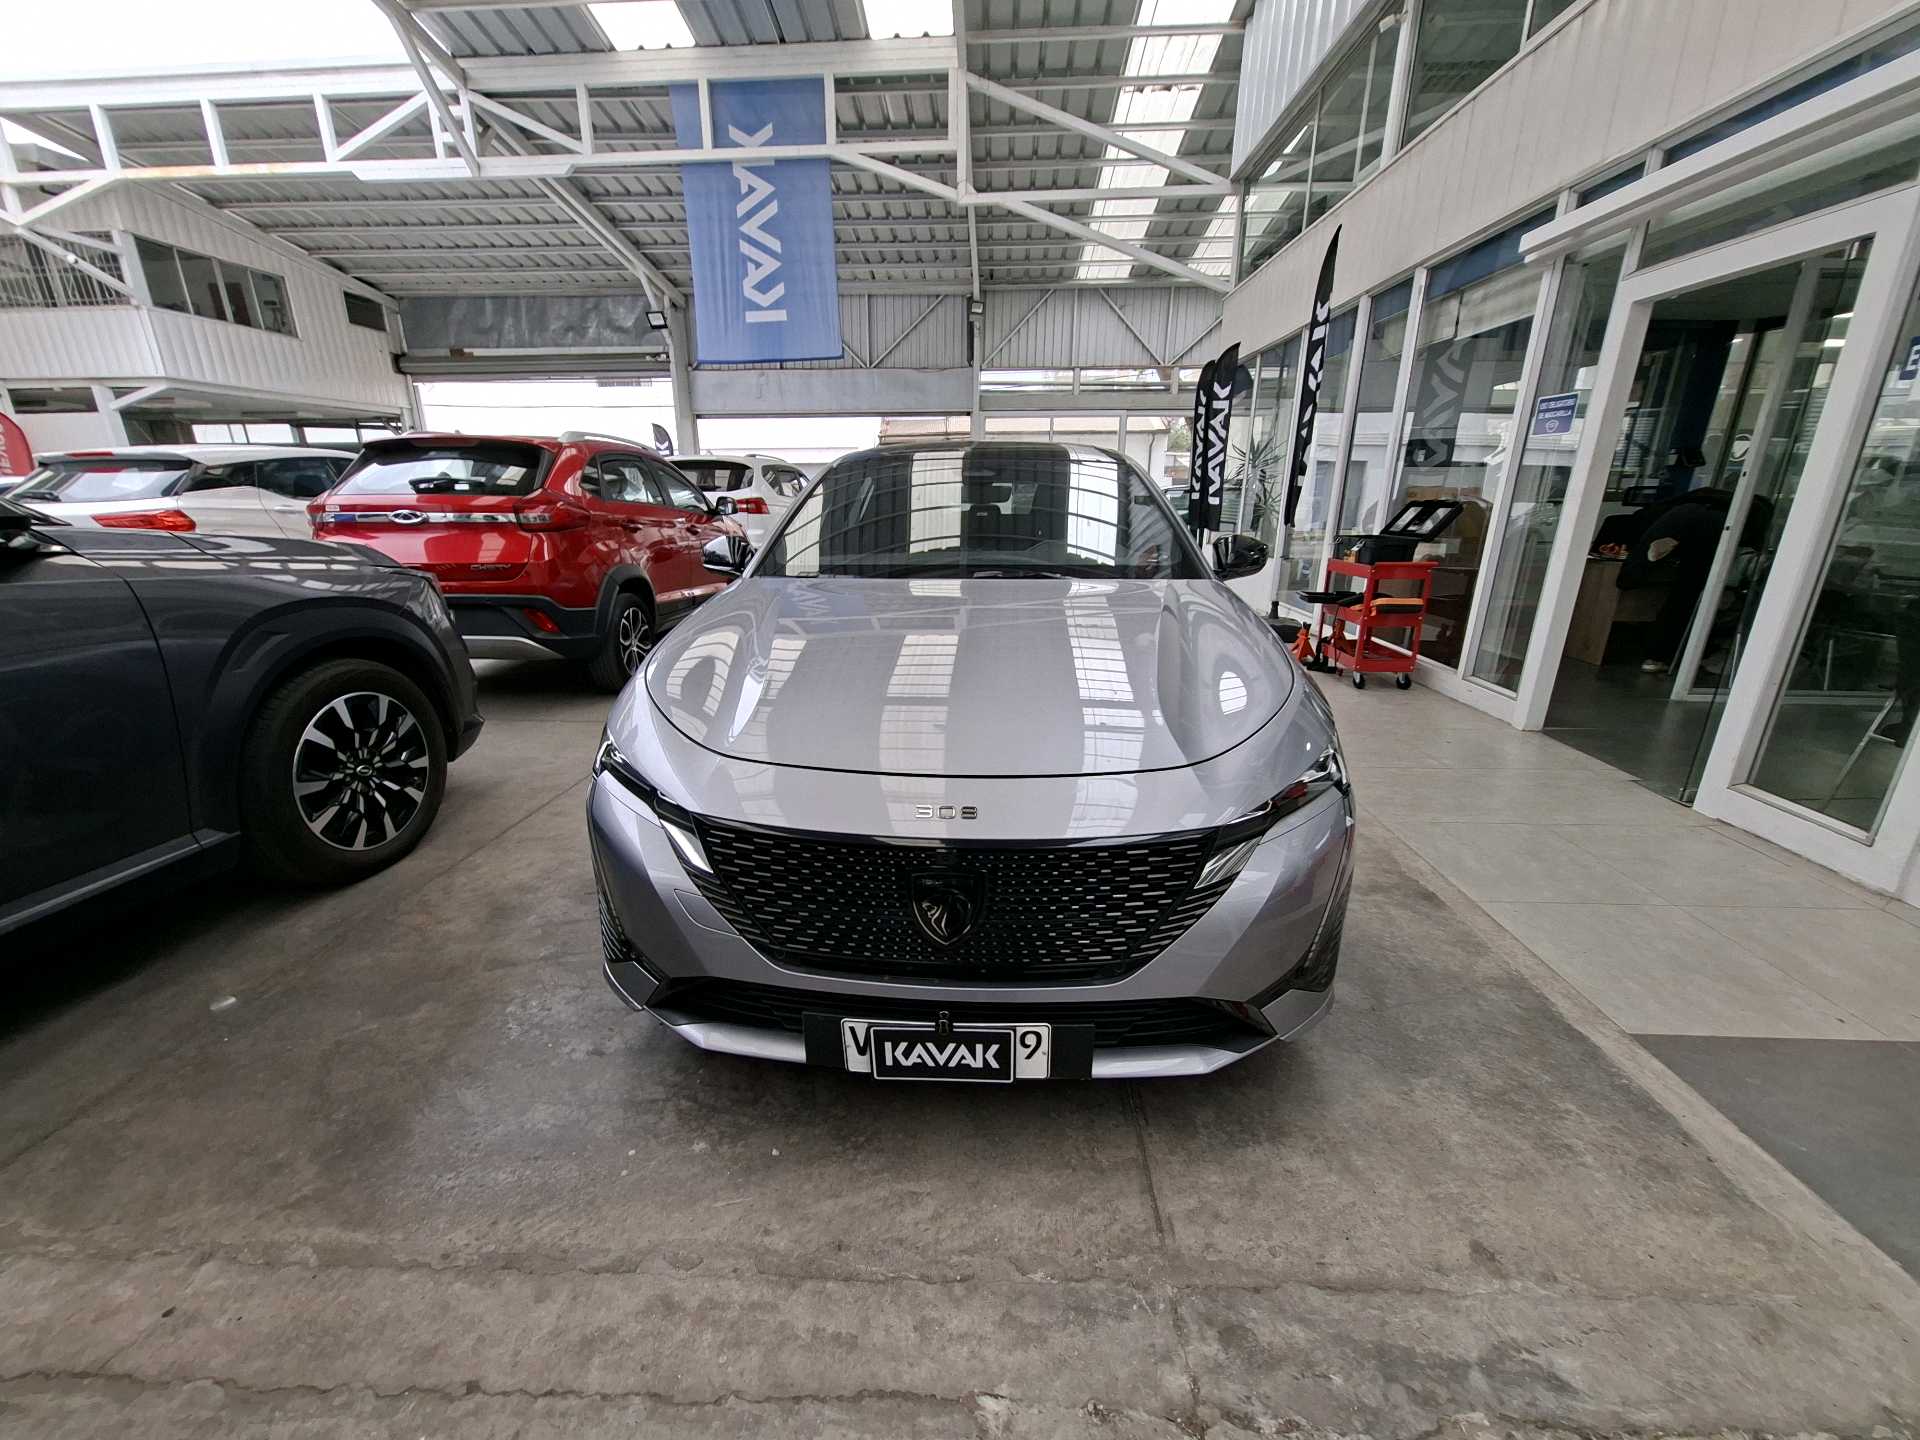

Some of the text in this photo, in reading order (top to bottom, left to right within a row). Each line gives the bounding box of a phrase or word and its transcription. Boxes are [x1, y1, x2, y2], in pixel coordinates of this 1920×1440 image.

[915, 805, 977, 819] 308
[885, 1041, 1000, 1069] KAVAK
[1019, 1030, 1042, 1060] 9
